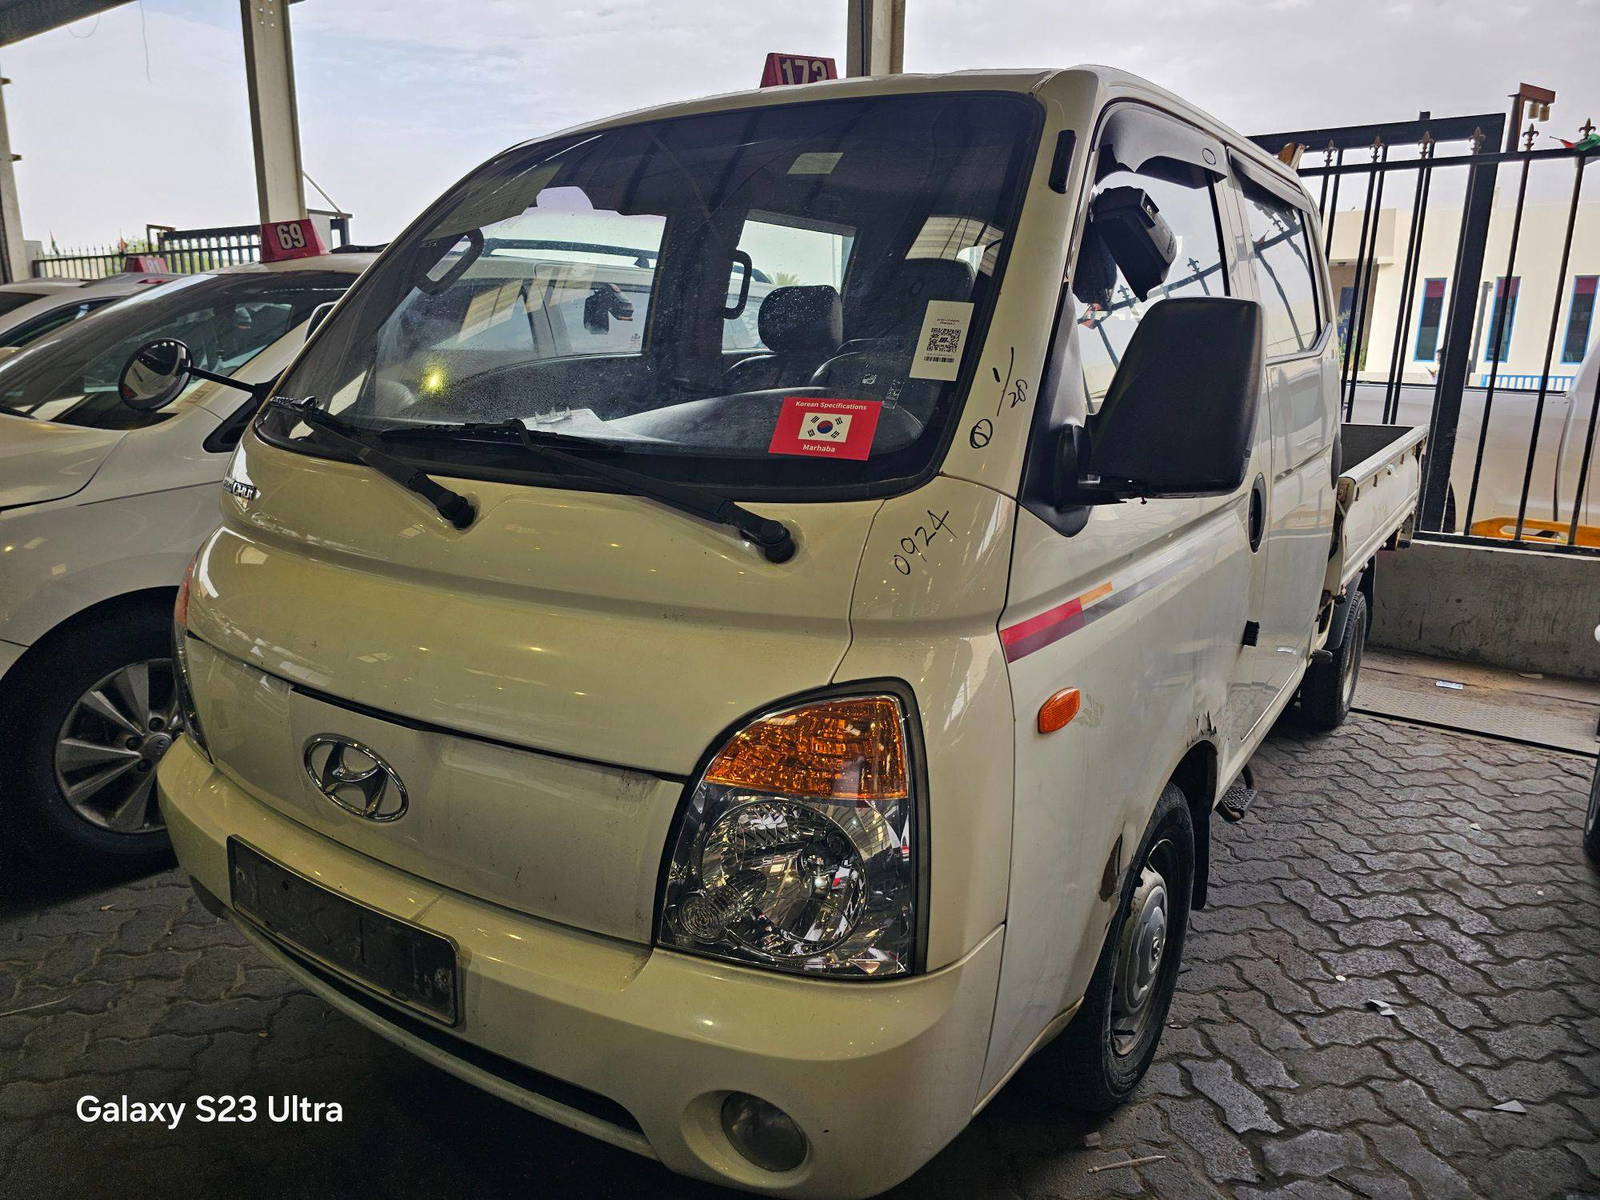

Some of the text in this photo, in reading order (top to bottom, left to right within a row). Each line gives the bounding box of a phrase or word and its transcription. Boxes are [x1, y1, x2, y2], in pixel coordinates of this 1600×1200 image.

[783, 59, 827, 85] 173
[277, 223, 306, 250] 69
[795, 400, 868, 411] Korean Specifications
[802, 443, 836, 453] Marhaba
[893, 510, 957, 576] 0924
